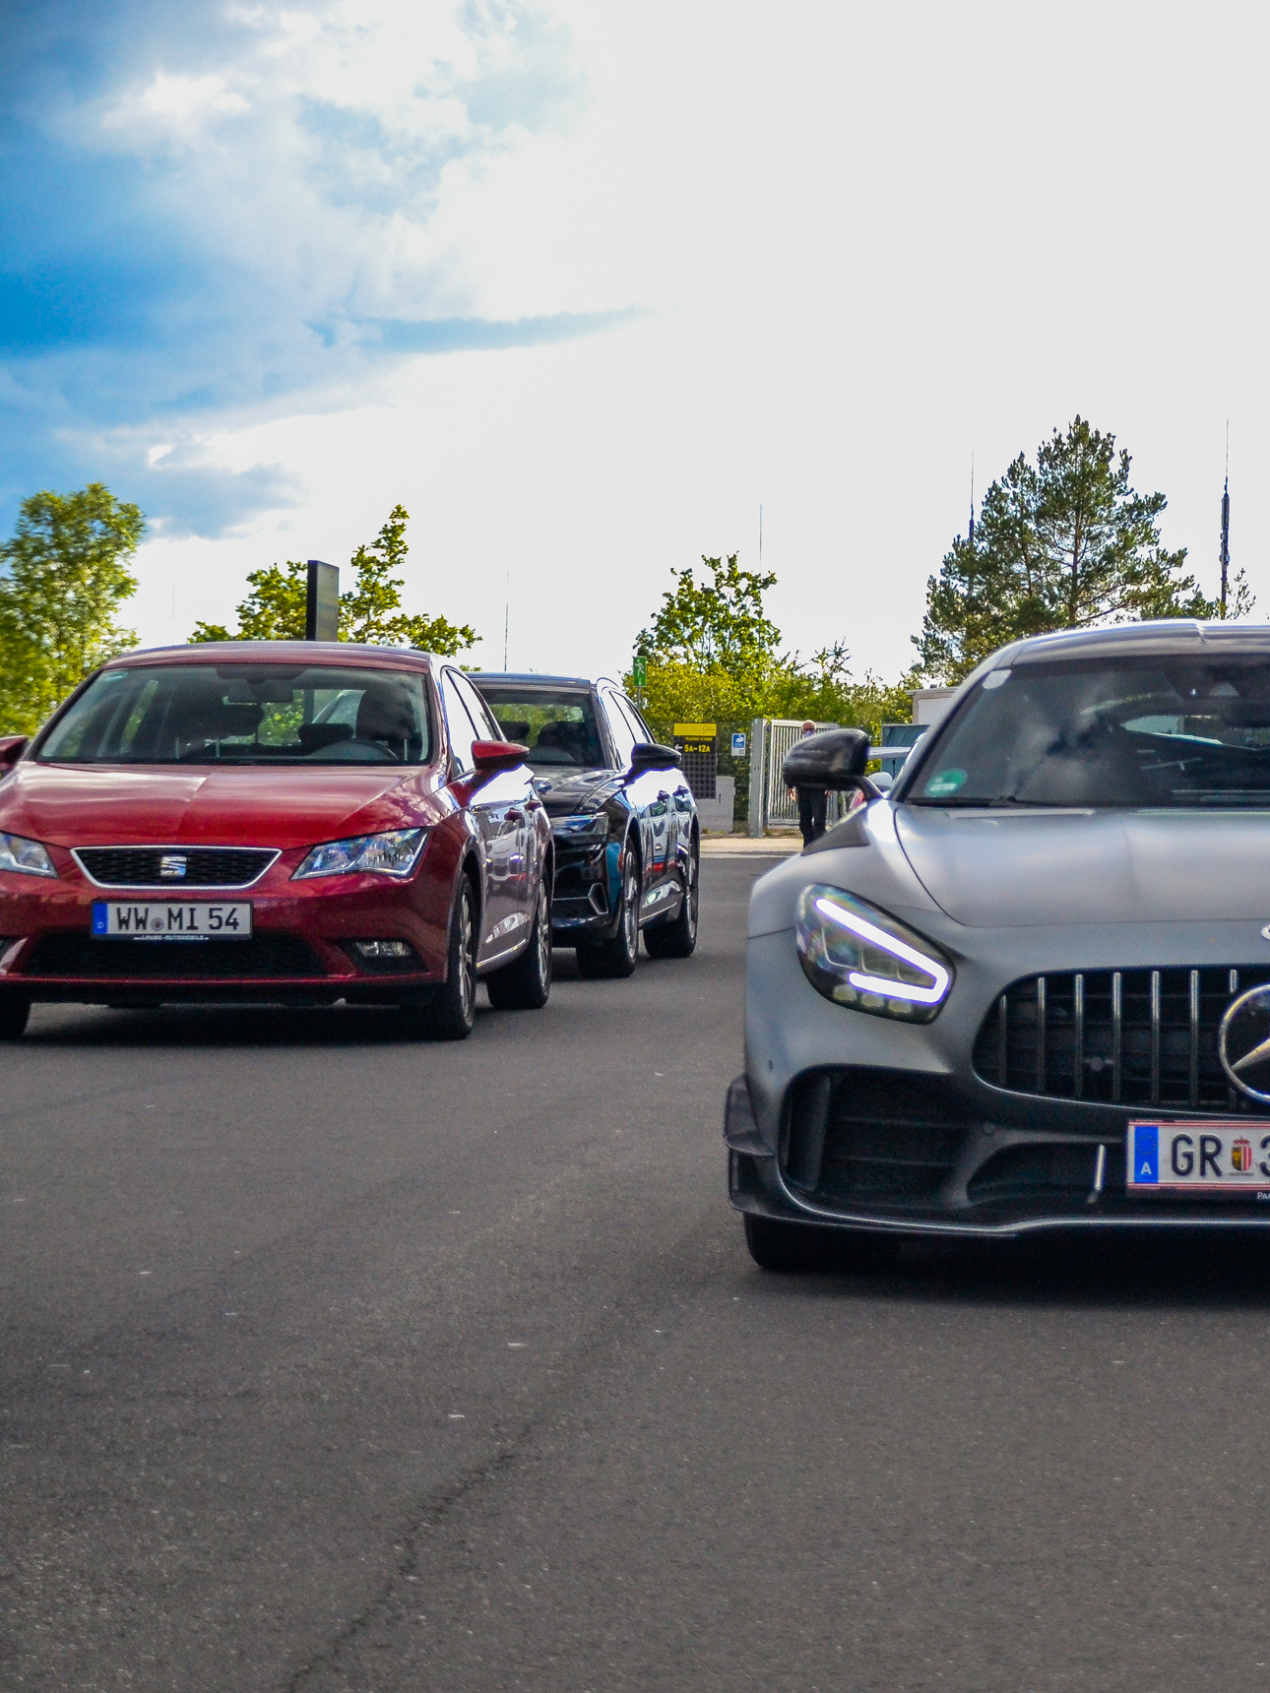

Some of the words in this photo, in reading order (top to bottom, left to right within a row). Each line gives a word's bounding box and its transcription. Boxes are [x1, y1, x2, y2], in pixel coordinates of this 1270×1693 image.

[116, 907, 149, 931] WW
[167, 907, 199, 931] MI
[208, 907, 240, 931] 54
[1170, 1133, 1223, 1177] GR
[1140, 1161, 1152, 1175] A
